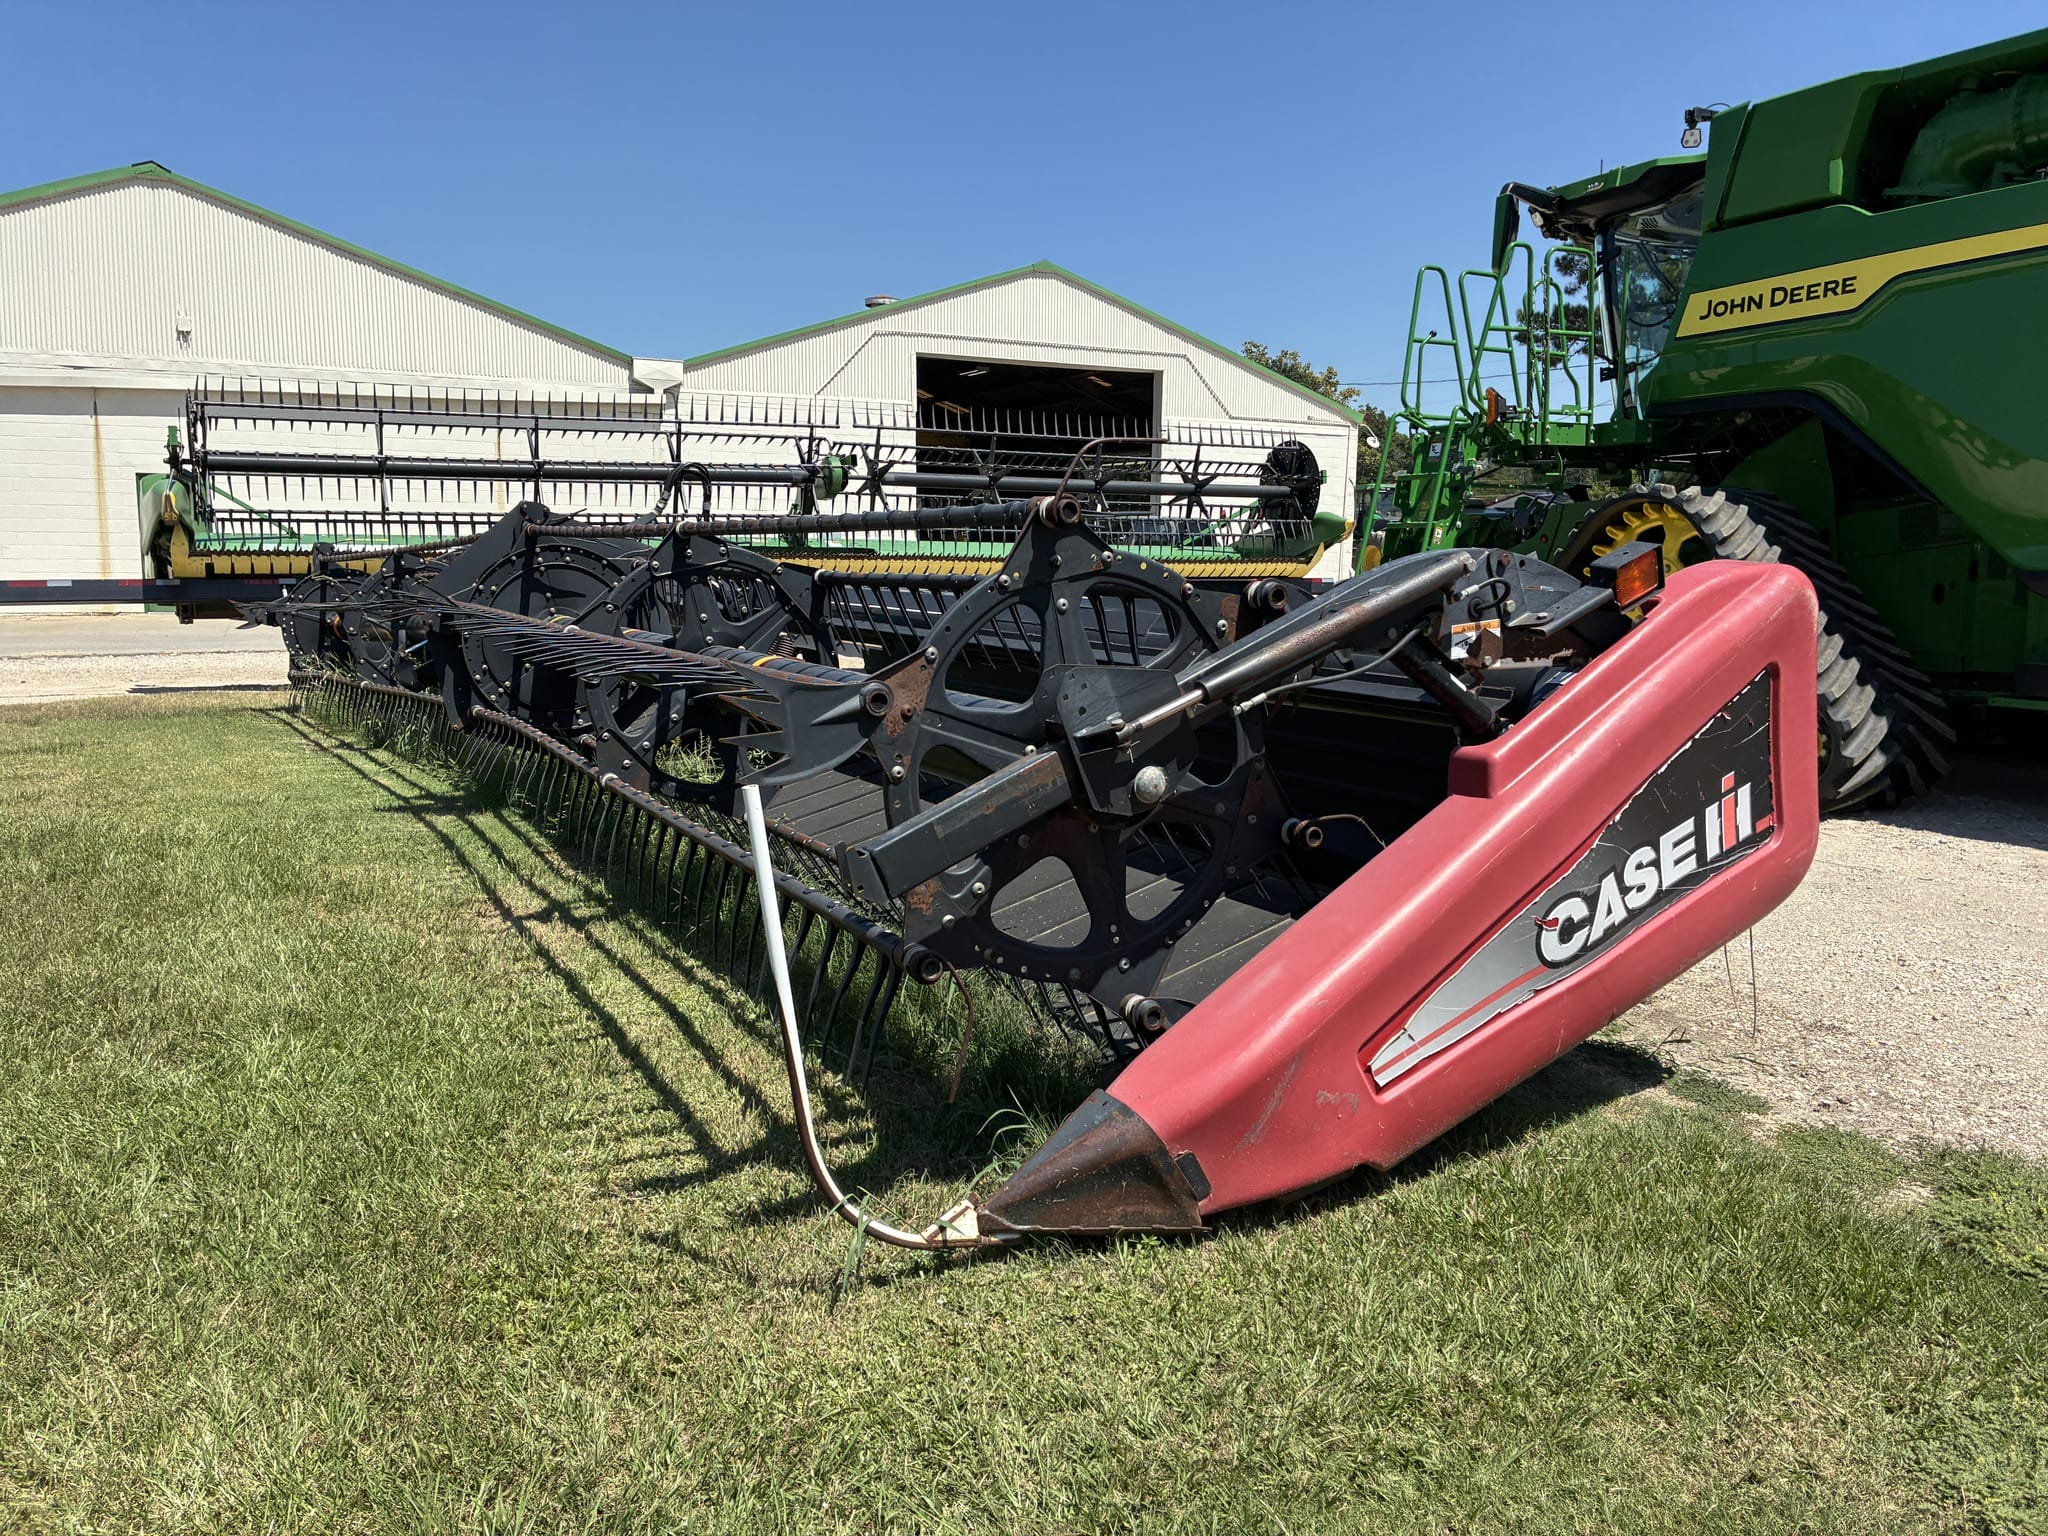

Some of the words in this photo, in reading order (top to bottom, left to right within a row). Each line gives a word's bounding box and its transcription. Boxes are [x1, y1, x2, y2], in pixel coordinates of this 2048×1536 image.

[1699, 294, 1763, 320] JOHN
[1770, 276, 1857, 307] DEERE
[1540, 816, 1698, 962] CASE
